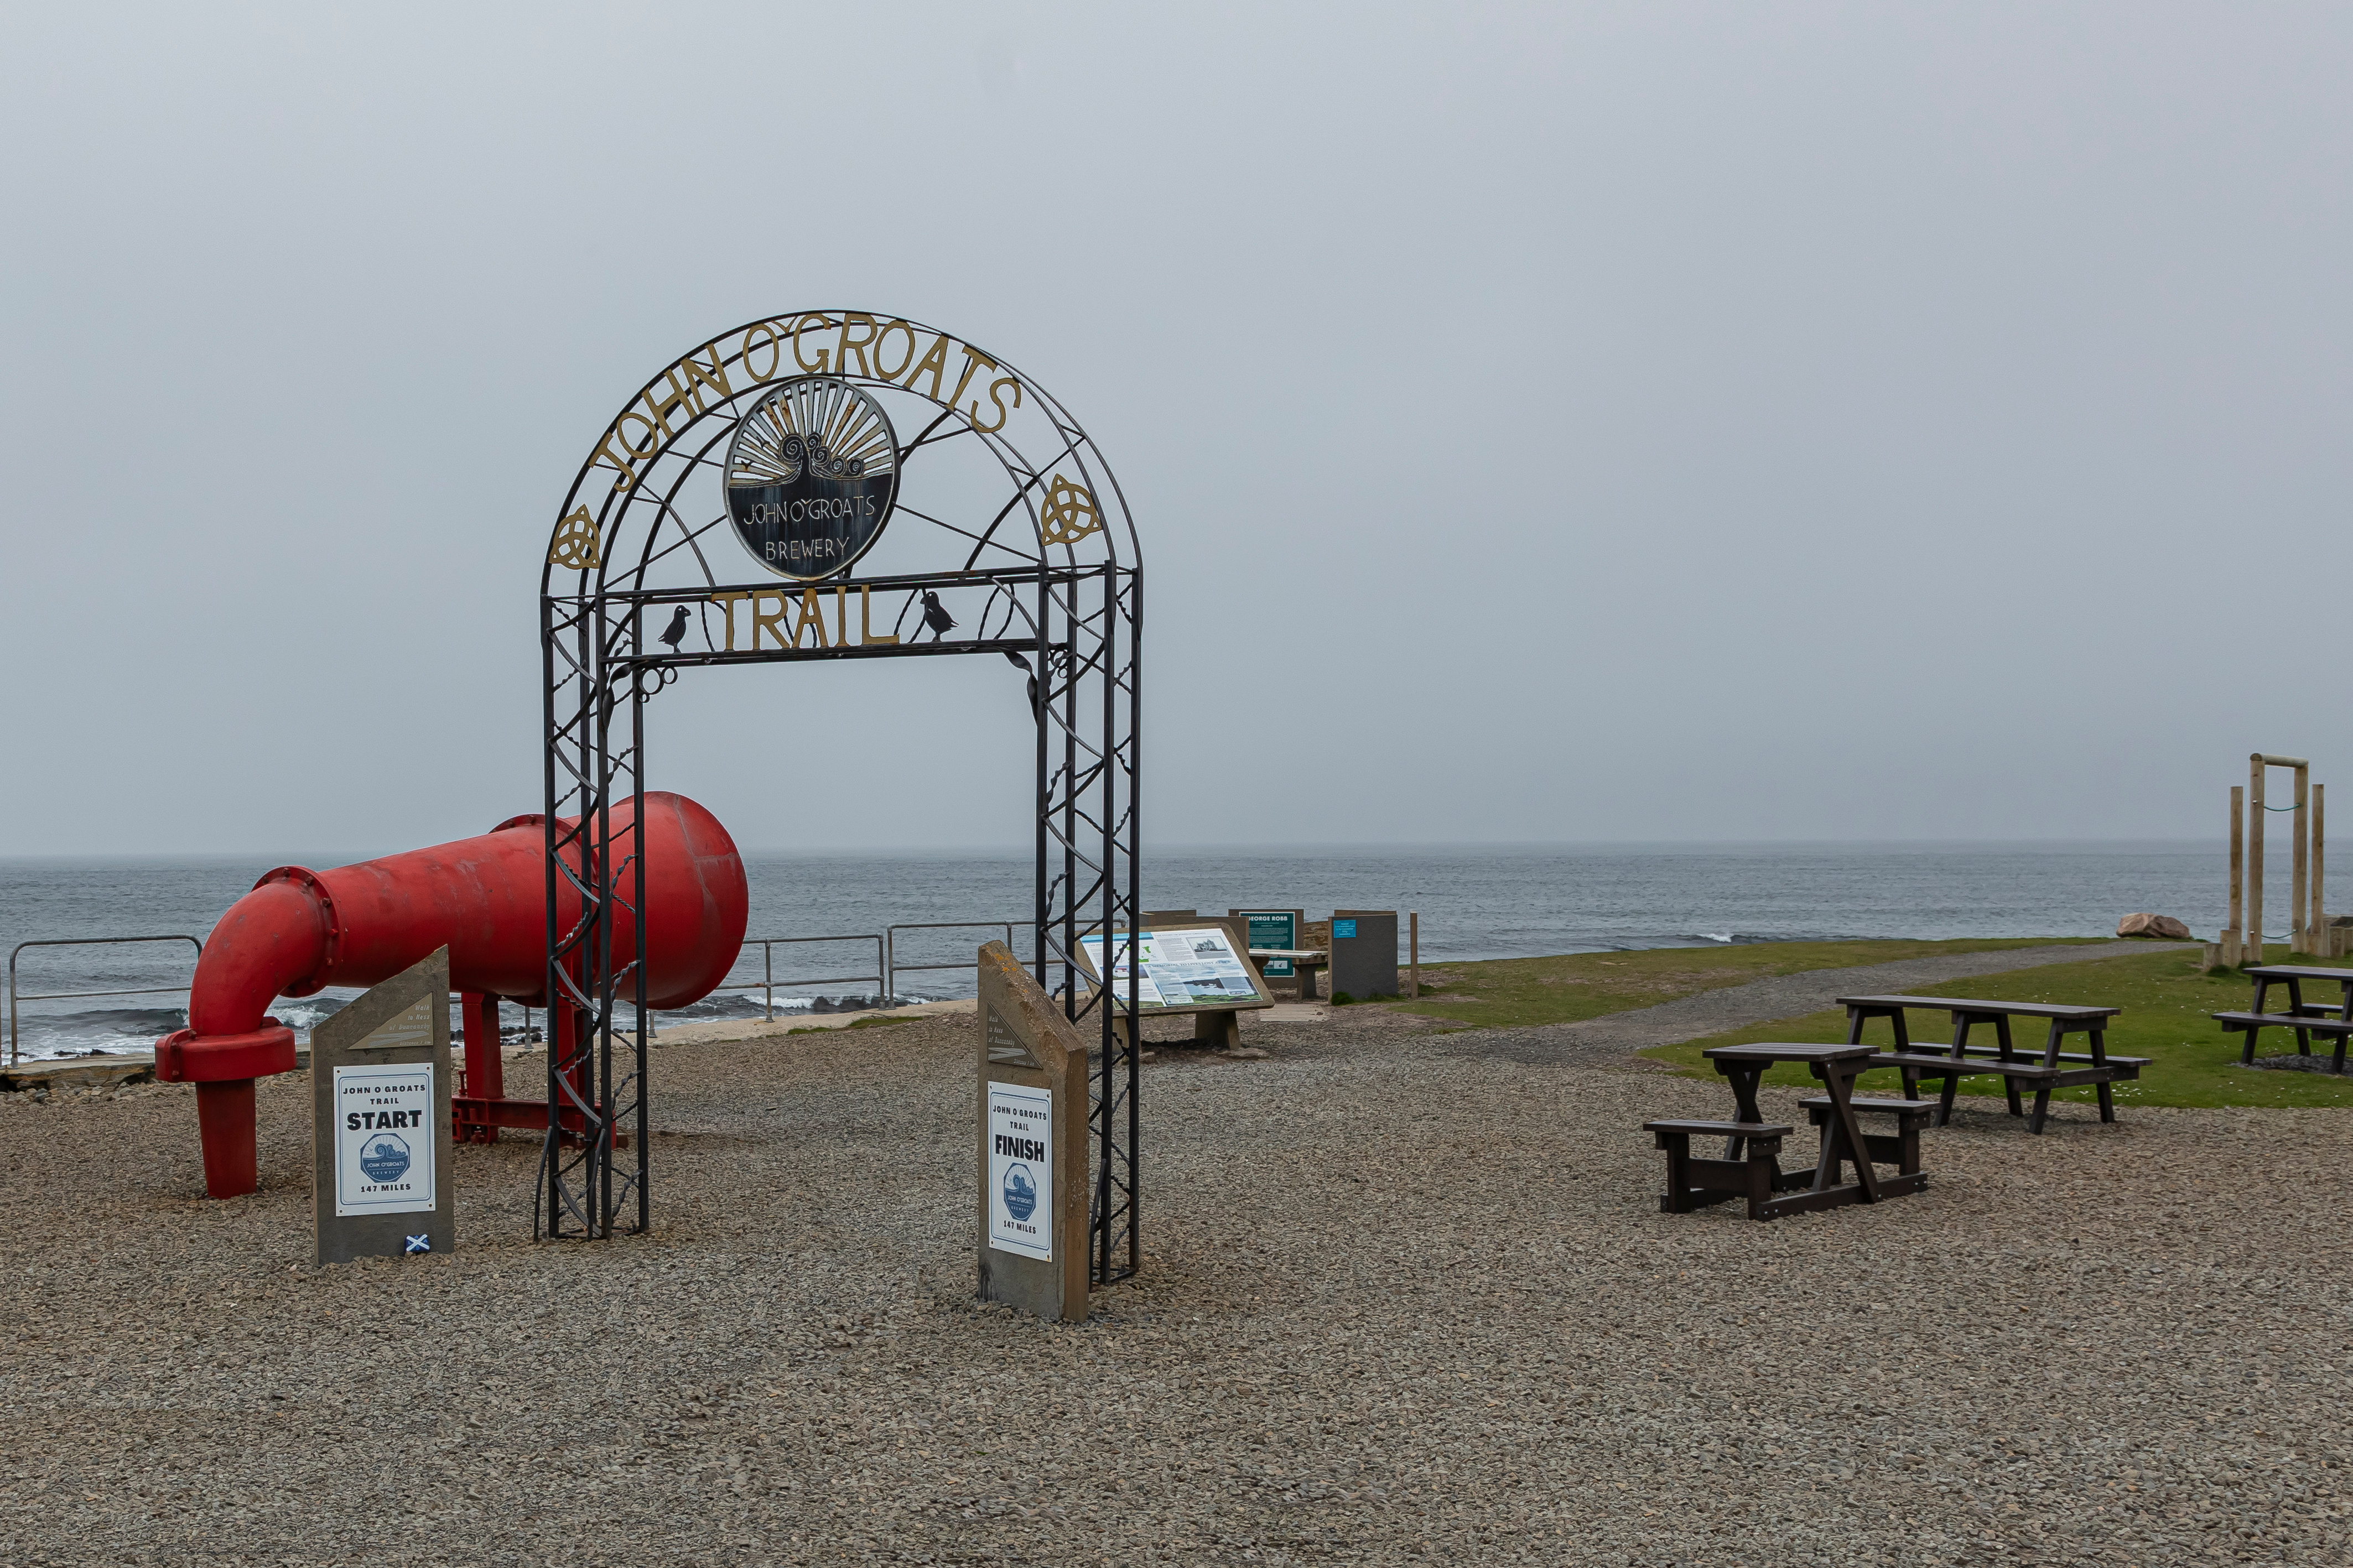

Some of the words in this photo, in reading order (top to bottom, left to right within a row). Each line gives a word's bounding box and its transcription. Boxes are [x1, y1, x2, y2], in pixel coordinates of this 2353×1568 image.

[588, 342, 734, 493] JOHN
[744, 501, 787, 524] JOHN
[766, 536, 850, 560] BREWERY
[711, 584, 900, 652] TRAIL
[347, 1109, 422, 1131] START
[993, 1105, 1011, 1115] JOHN
[1010, 1121, 1029, 1132] TRAIL
[995, 1134, 1045, 1163] FINISH
[1004, 1220, 1015, 1229] 147
[1016, 1222, 1036, 1234] MILES
